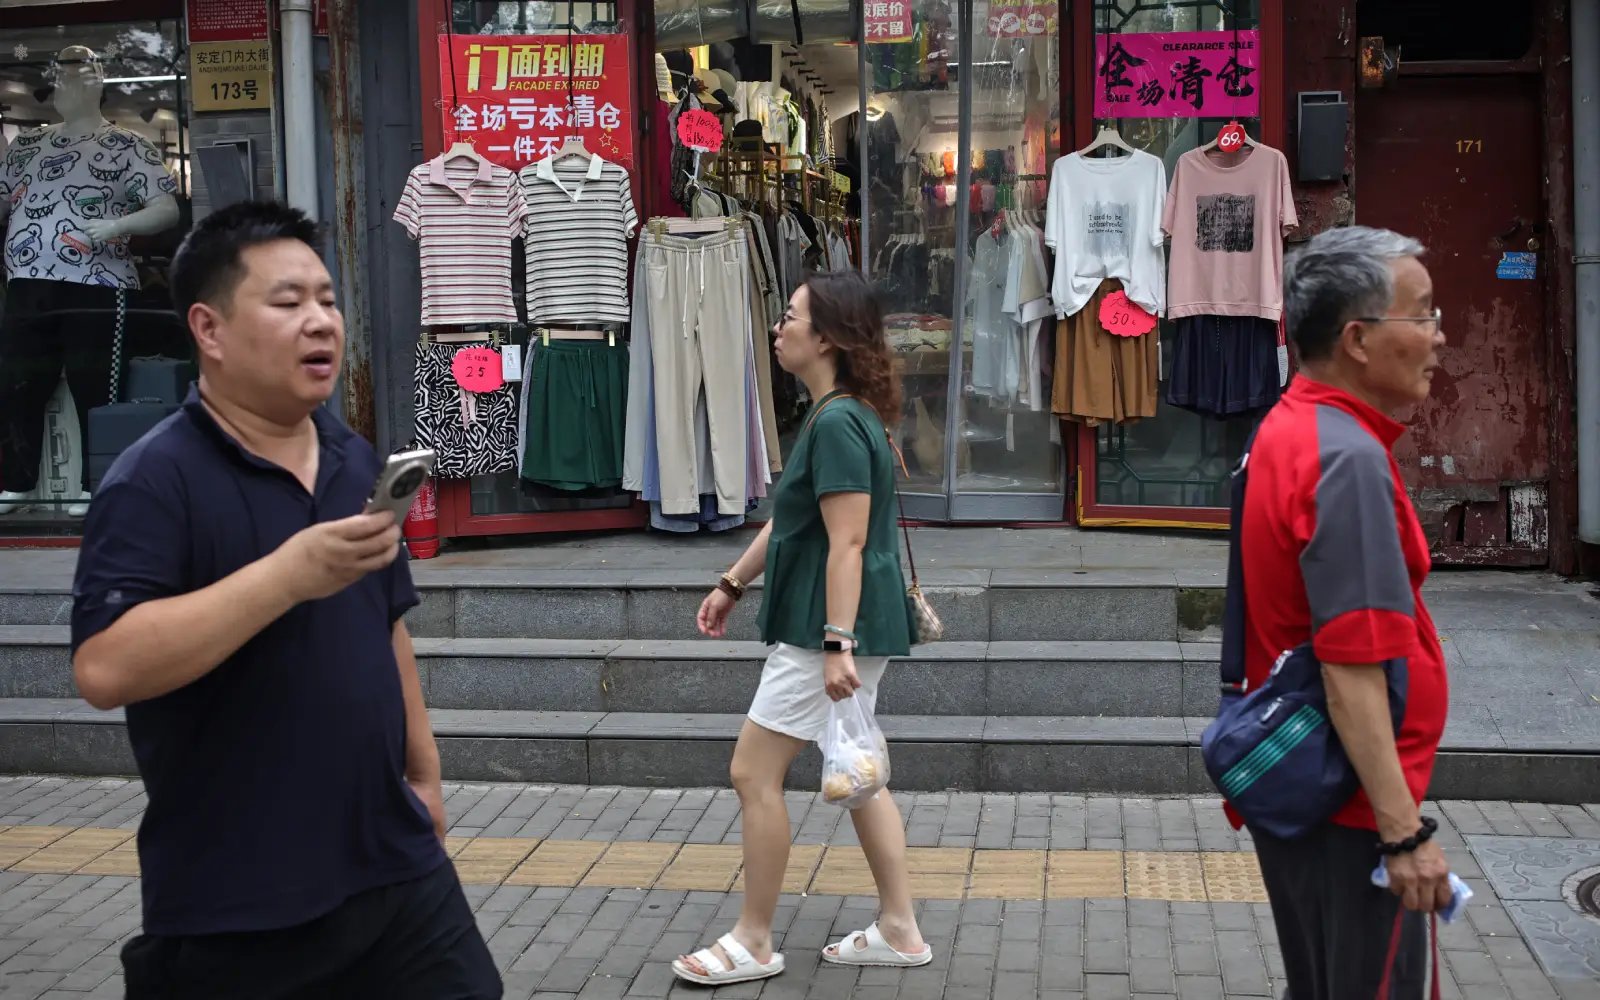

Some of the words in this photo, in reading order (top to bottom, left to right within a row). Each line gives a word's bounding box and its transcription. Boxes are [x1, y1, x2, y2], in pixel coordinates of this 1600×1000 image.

[196, 48, 269, 64] 安定门内大街
[464, 43, 605, 92] 门面到期
[1099, 41, 1256, 110] 全场清仓
[211, 80, 258, 101] 173号
[509, 81, 551, 91] FACADE
[554, 80, 600, 90] EXPIRED
[1106, 94, 1130, 102] SALE
[452, 94, 621, 131] 全场亏本清仓
[1456, 140, 1482, 153] 171
[465, 366, 485, 378] 25
